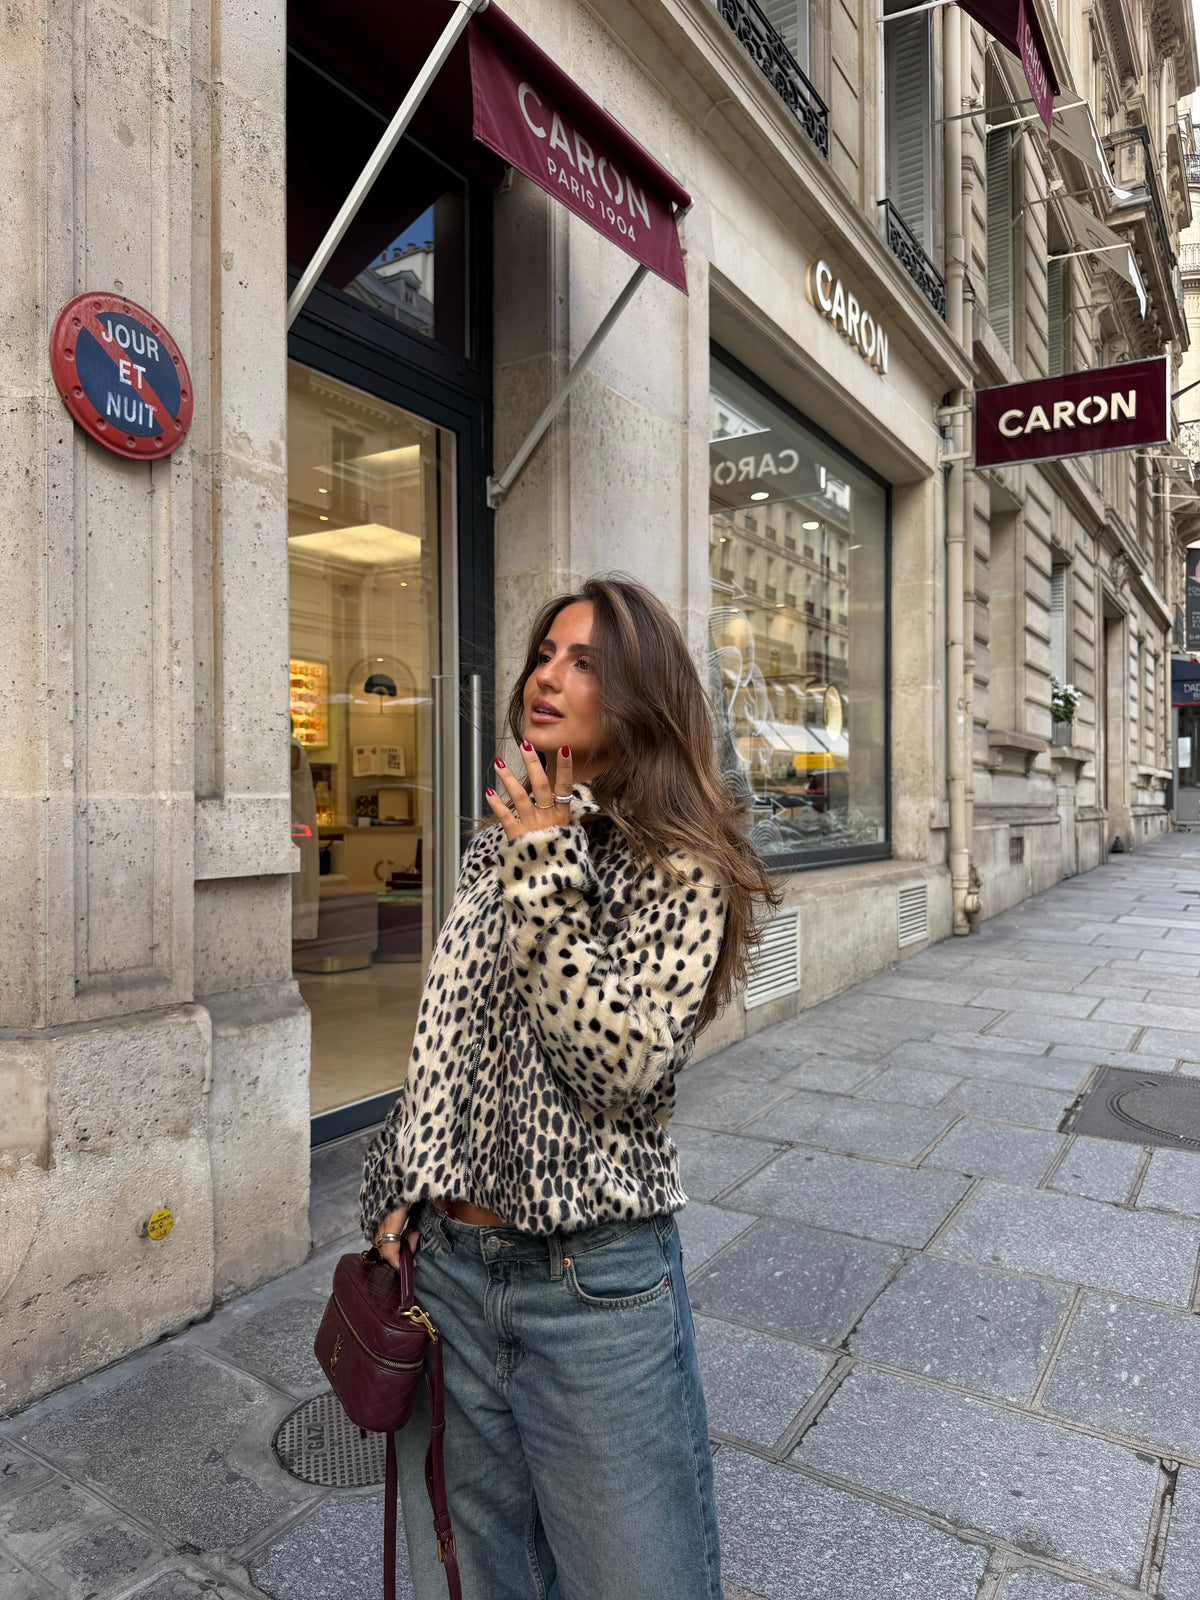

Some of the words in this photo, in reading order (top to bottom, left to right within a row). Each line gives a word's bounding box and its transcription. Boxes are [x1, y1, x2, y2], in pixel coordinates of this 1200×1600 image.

[518, 82, 650, 230] CARON
[547, 157, 594, 210] PARIS
[600, 200, 636, 242] 1904
[815, 260, 888, 374] CARON
[101, 319, 160, 362] JOUR
[119, 359, 146, 389] ET
[106, 391, 157, 428] NUIT
[998, 389, 1137, 438] CARON
[307, 1425, 325, 1450] GAZ
